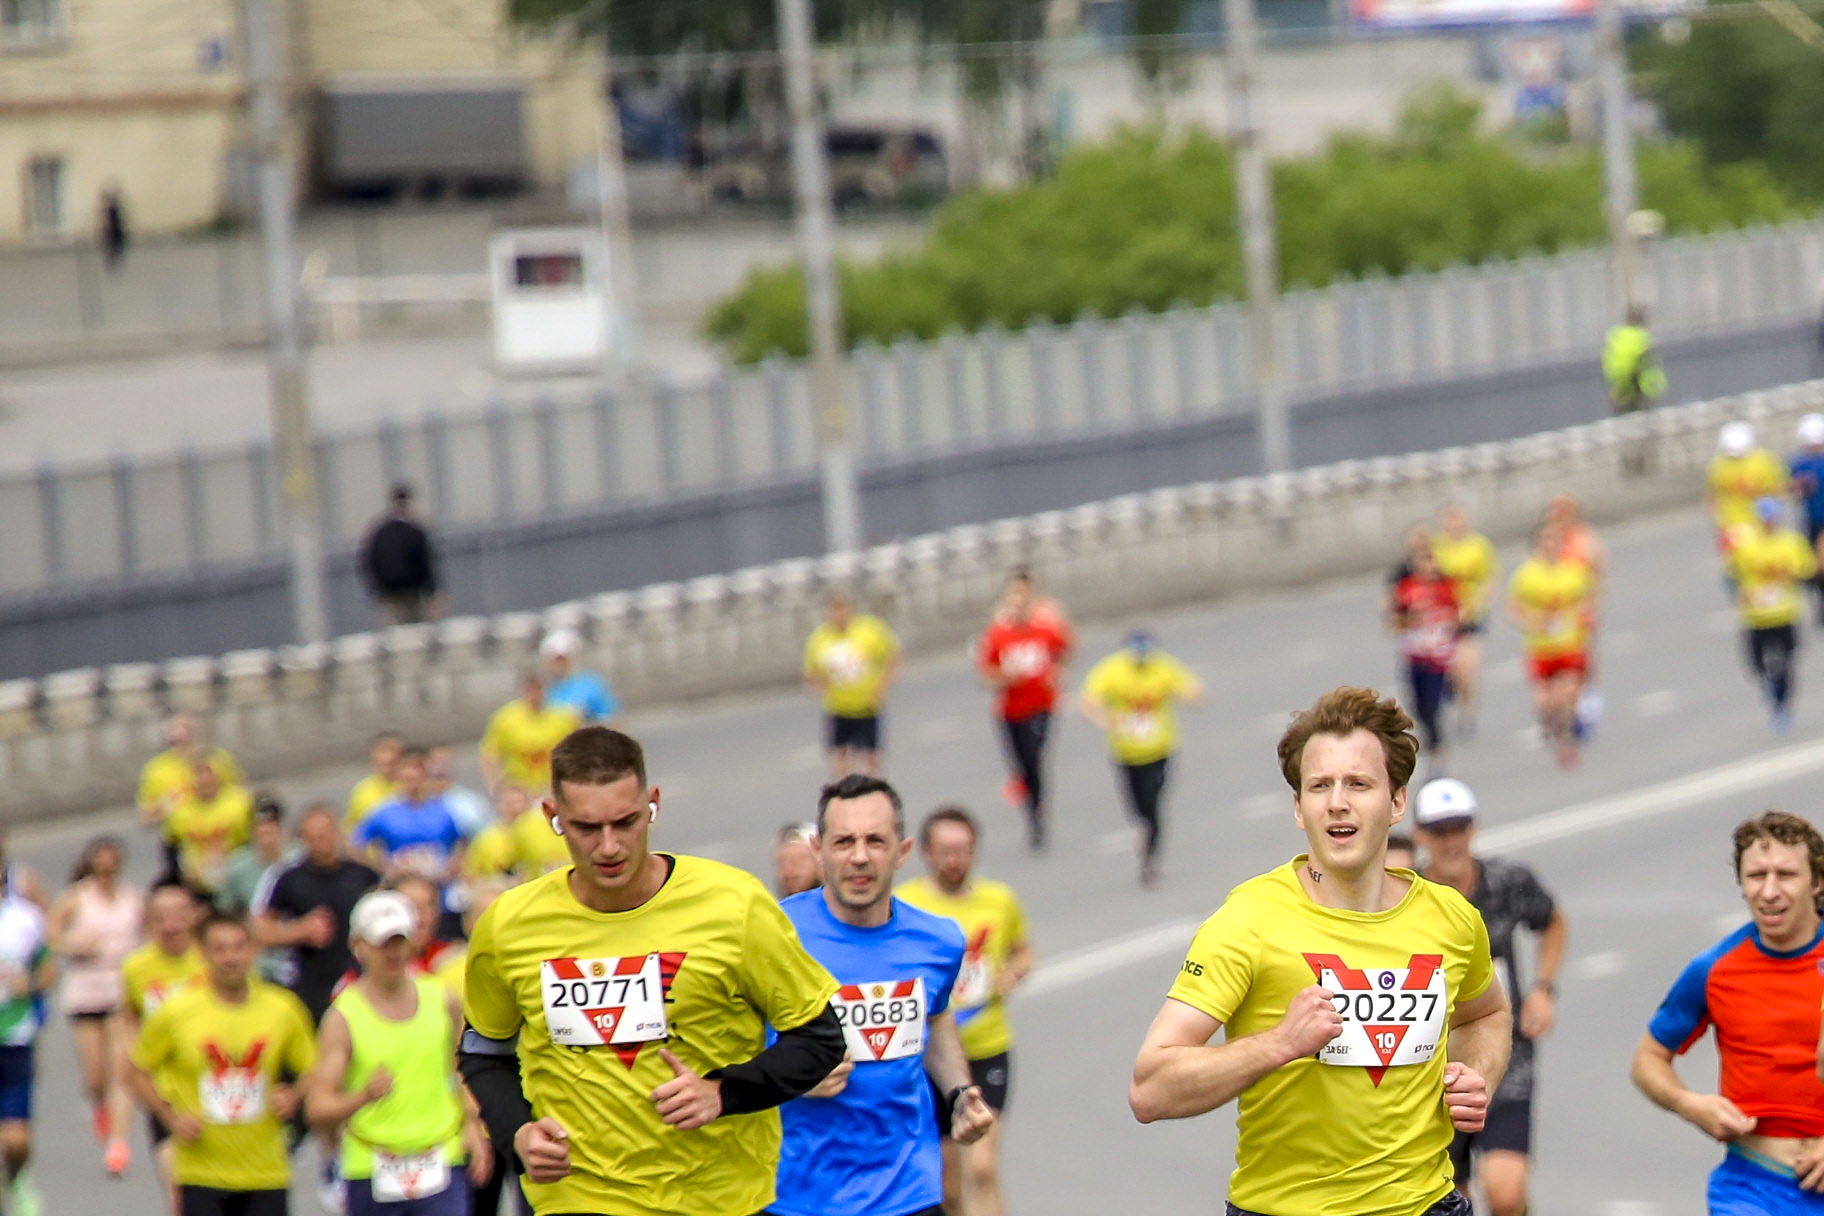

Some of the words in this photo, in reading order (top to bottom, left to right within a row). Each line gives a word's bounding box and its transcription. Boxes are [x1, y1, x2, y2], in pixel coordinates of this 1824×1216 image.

[550, 977, 648, 1008] 20771
[833, 998, 918, 1027] 20683
[1332, 993, 1438, 1021] 20227
[593, 1013, 615, 1028] 10
[869, 1032, 886, 1047] 10
[1375, 1032, 1396, 1048] 10
